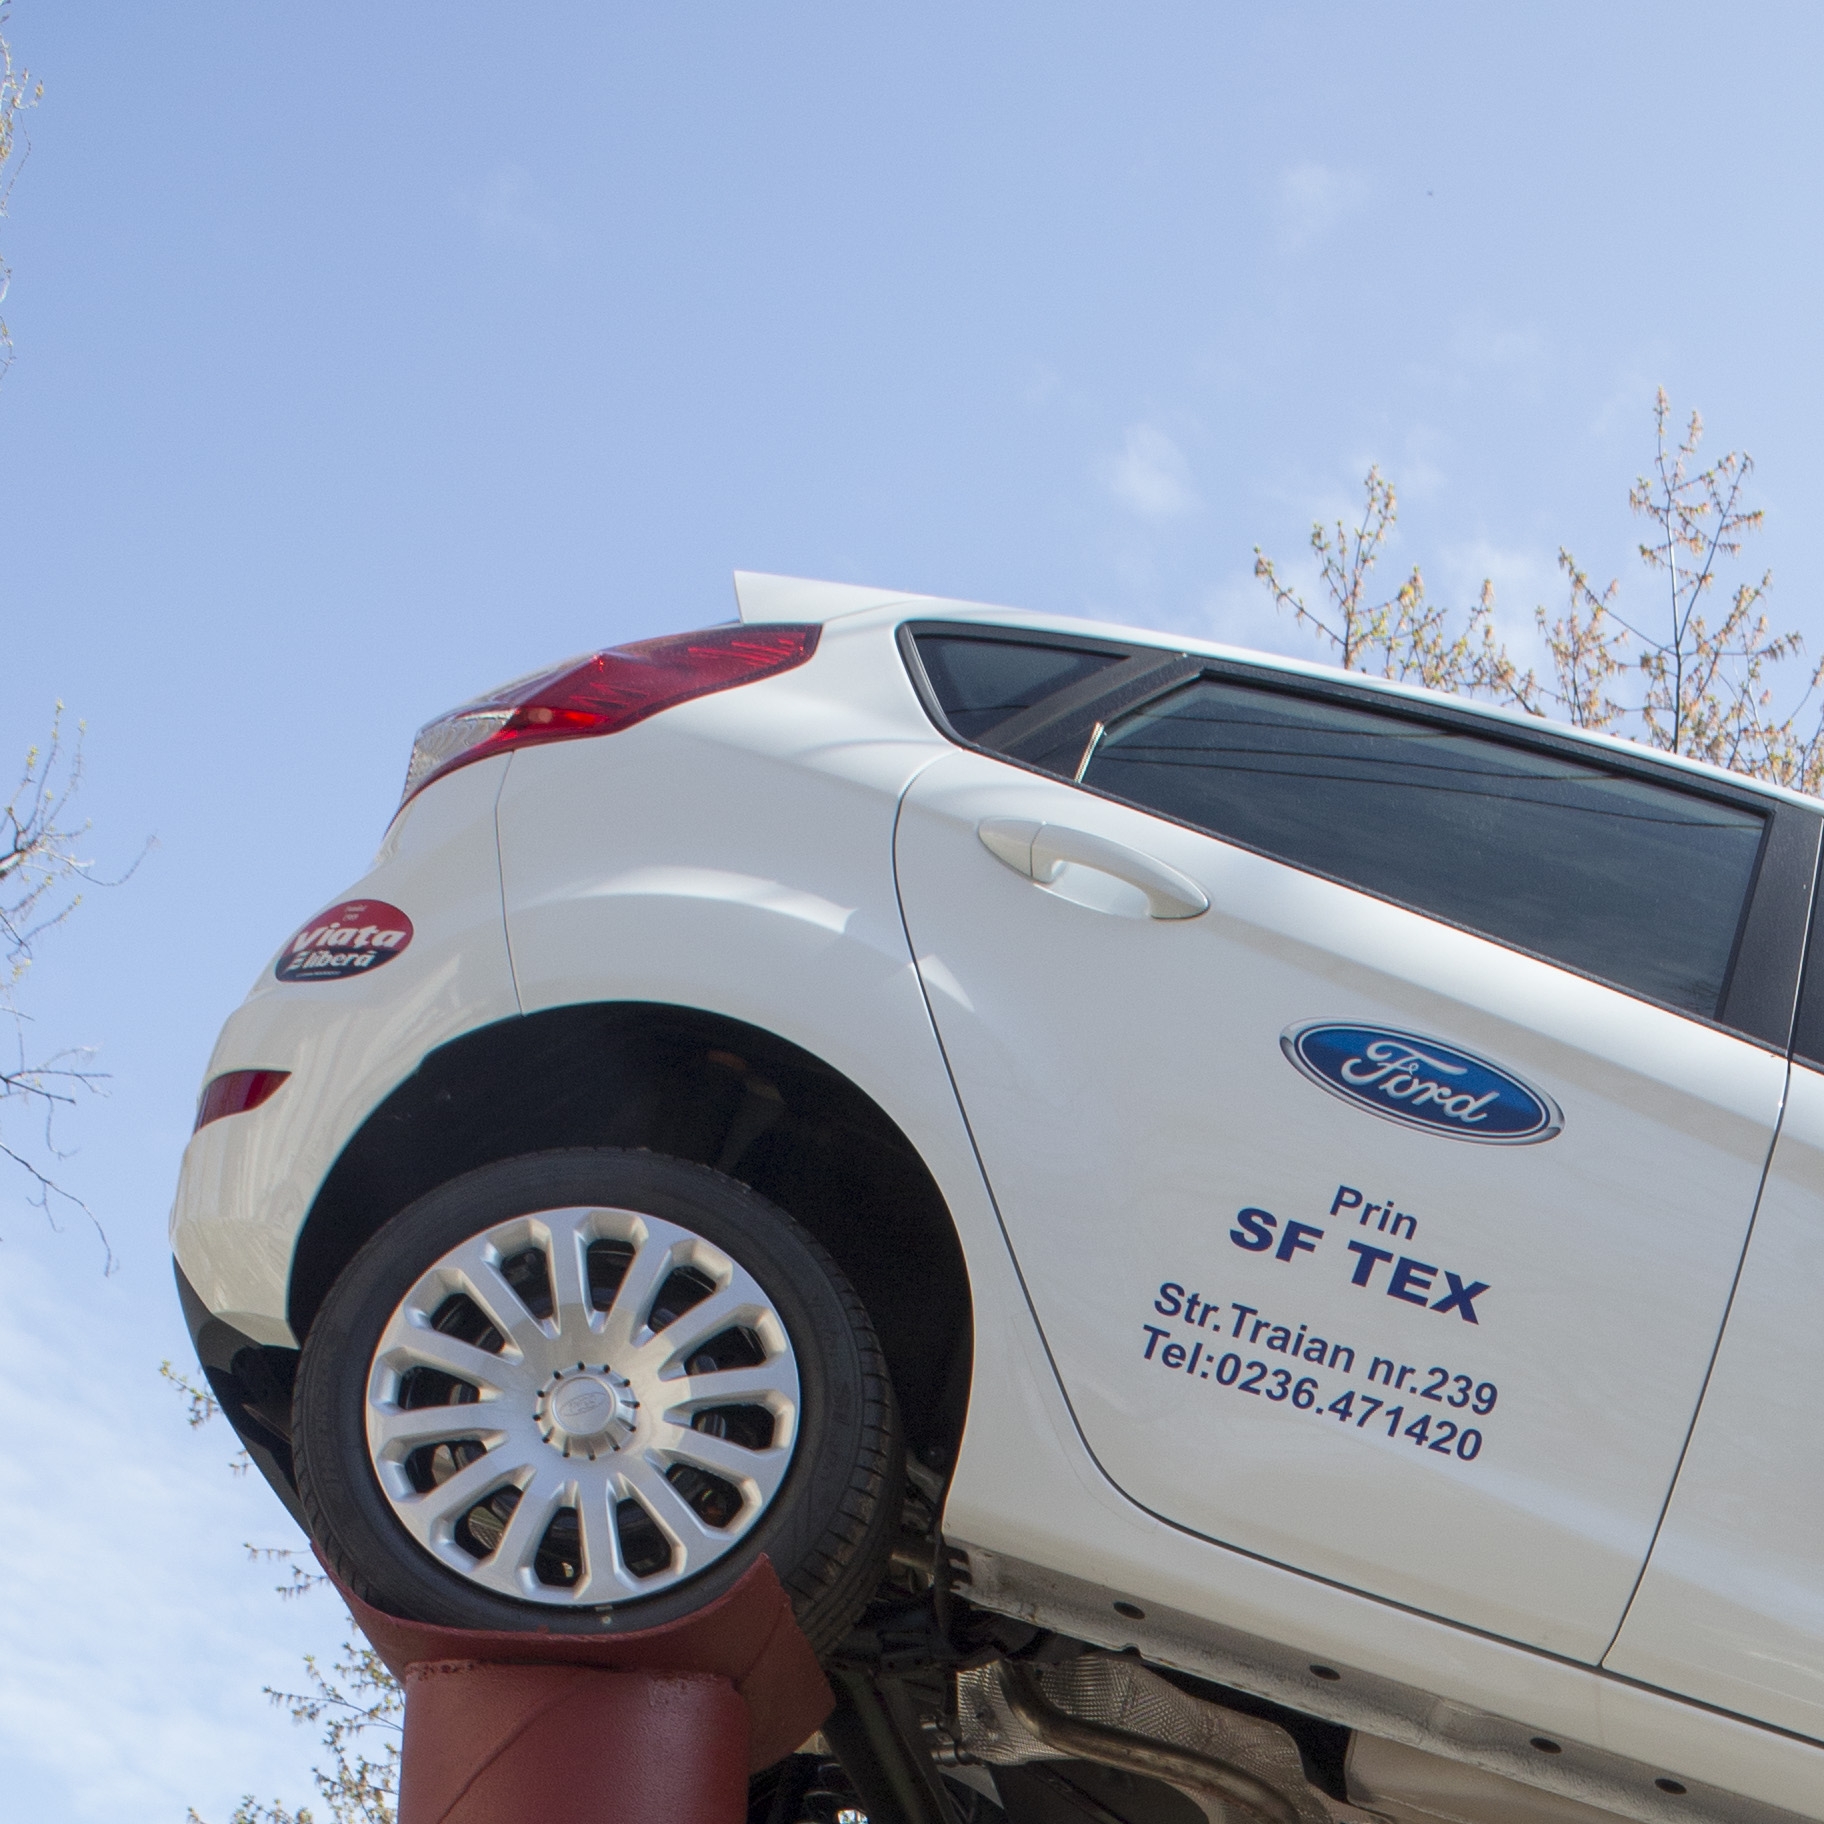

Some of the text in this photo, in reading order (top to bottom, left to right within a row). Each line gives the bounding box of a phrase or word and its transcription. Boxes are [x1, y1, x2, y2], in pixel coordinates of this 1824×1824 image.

[1341, 1040, 1500, 1124] Ford
[1229, 1207, 1492, 1325] SF TEX
[1329, 1184, 1419, 1241] Prin
[1141, 1324, 1484, 1461] Tel:0236.471420
[1153, 1282, 1499, 1417] Str.Traian nr.239
